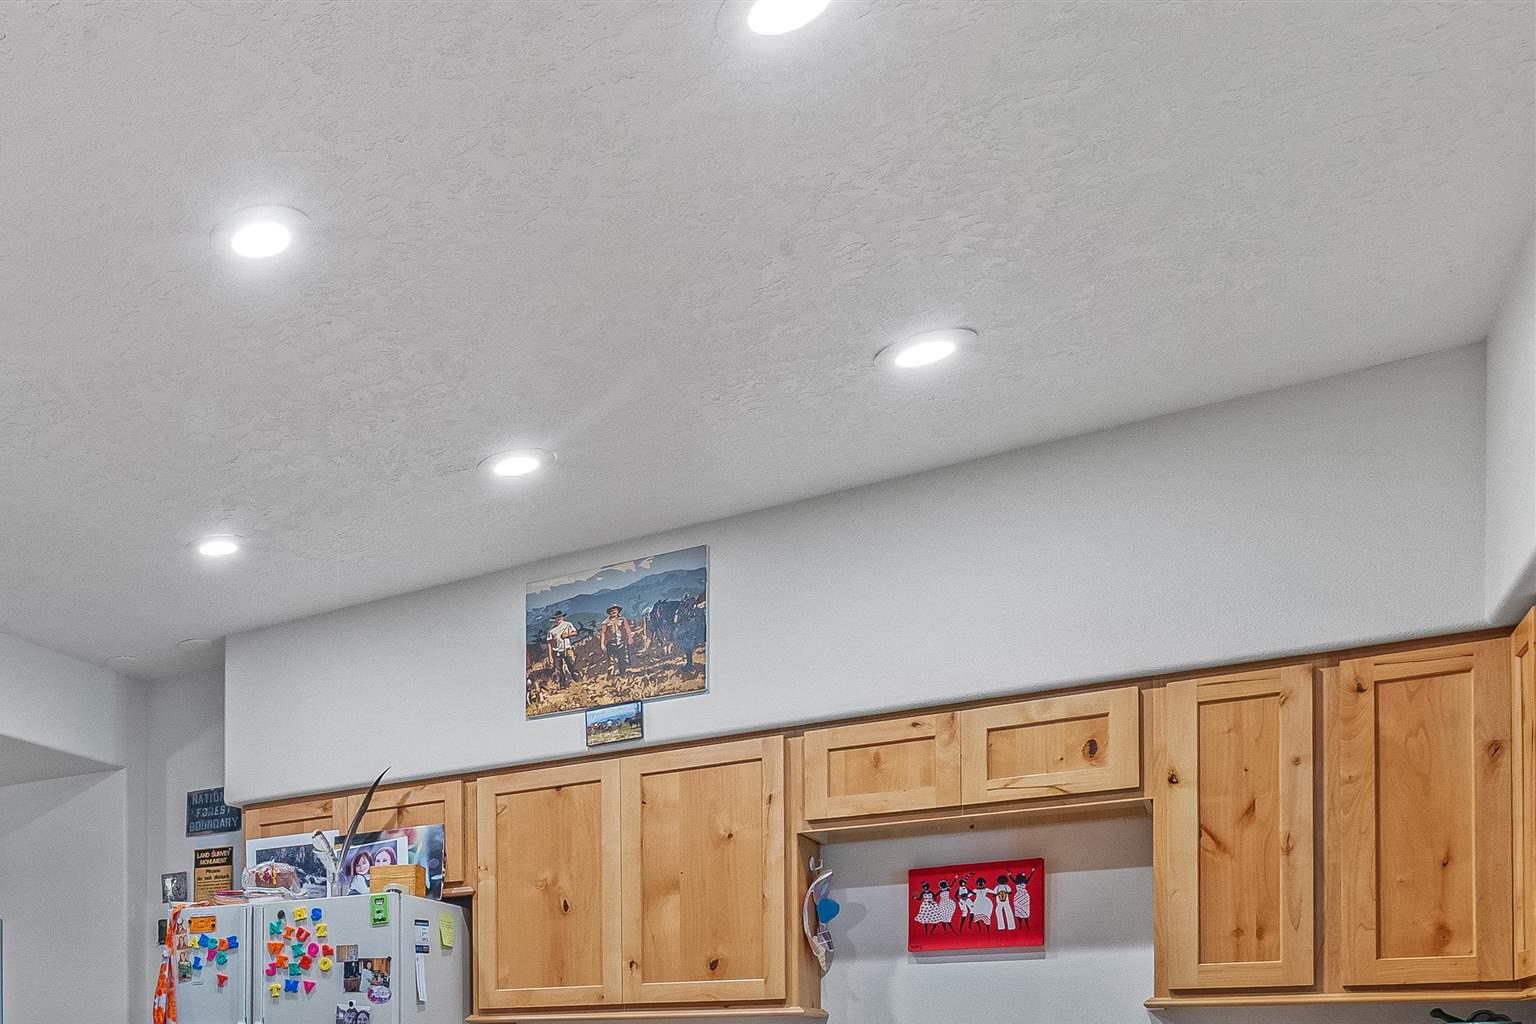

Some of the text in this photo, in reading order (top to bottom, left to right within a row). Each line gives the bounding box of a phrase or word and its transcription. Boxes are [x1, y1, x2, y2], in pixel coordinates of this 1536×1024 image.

[189, 816, 239, 832] BOUNDARY
[197, 848, 231, 859] LAND SURVEY
[199, 857, 227, 865] MONUMENT
